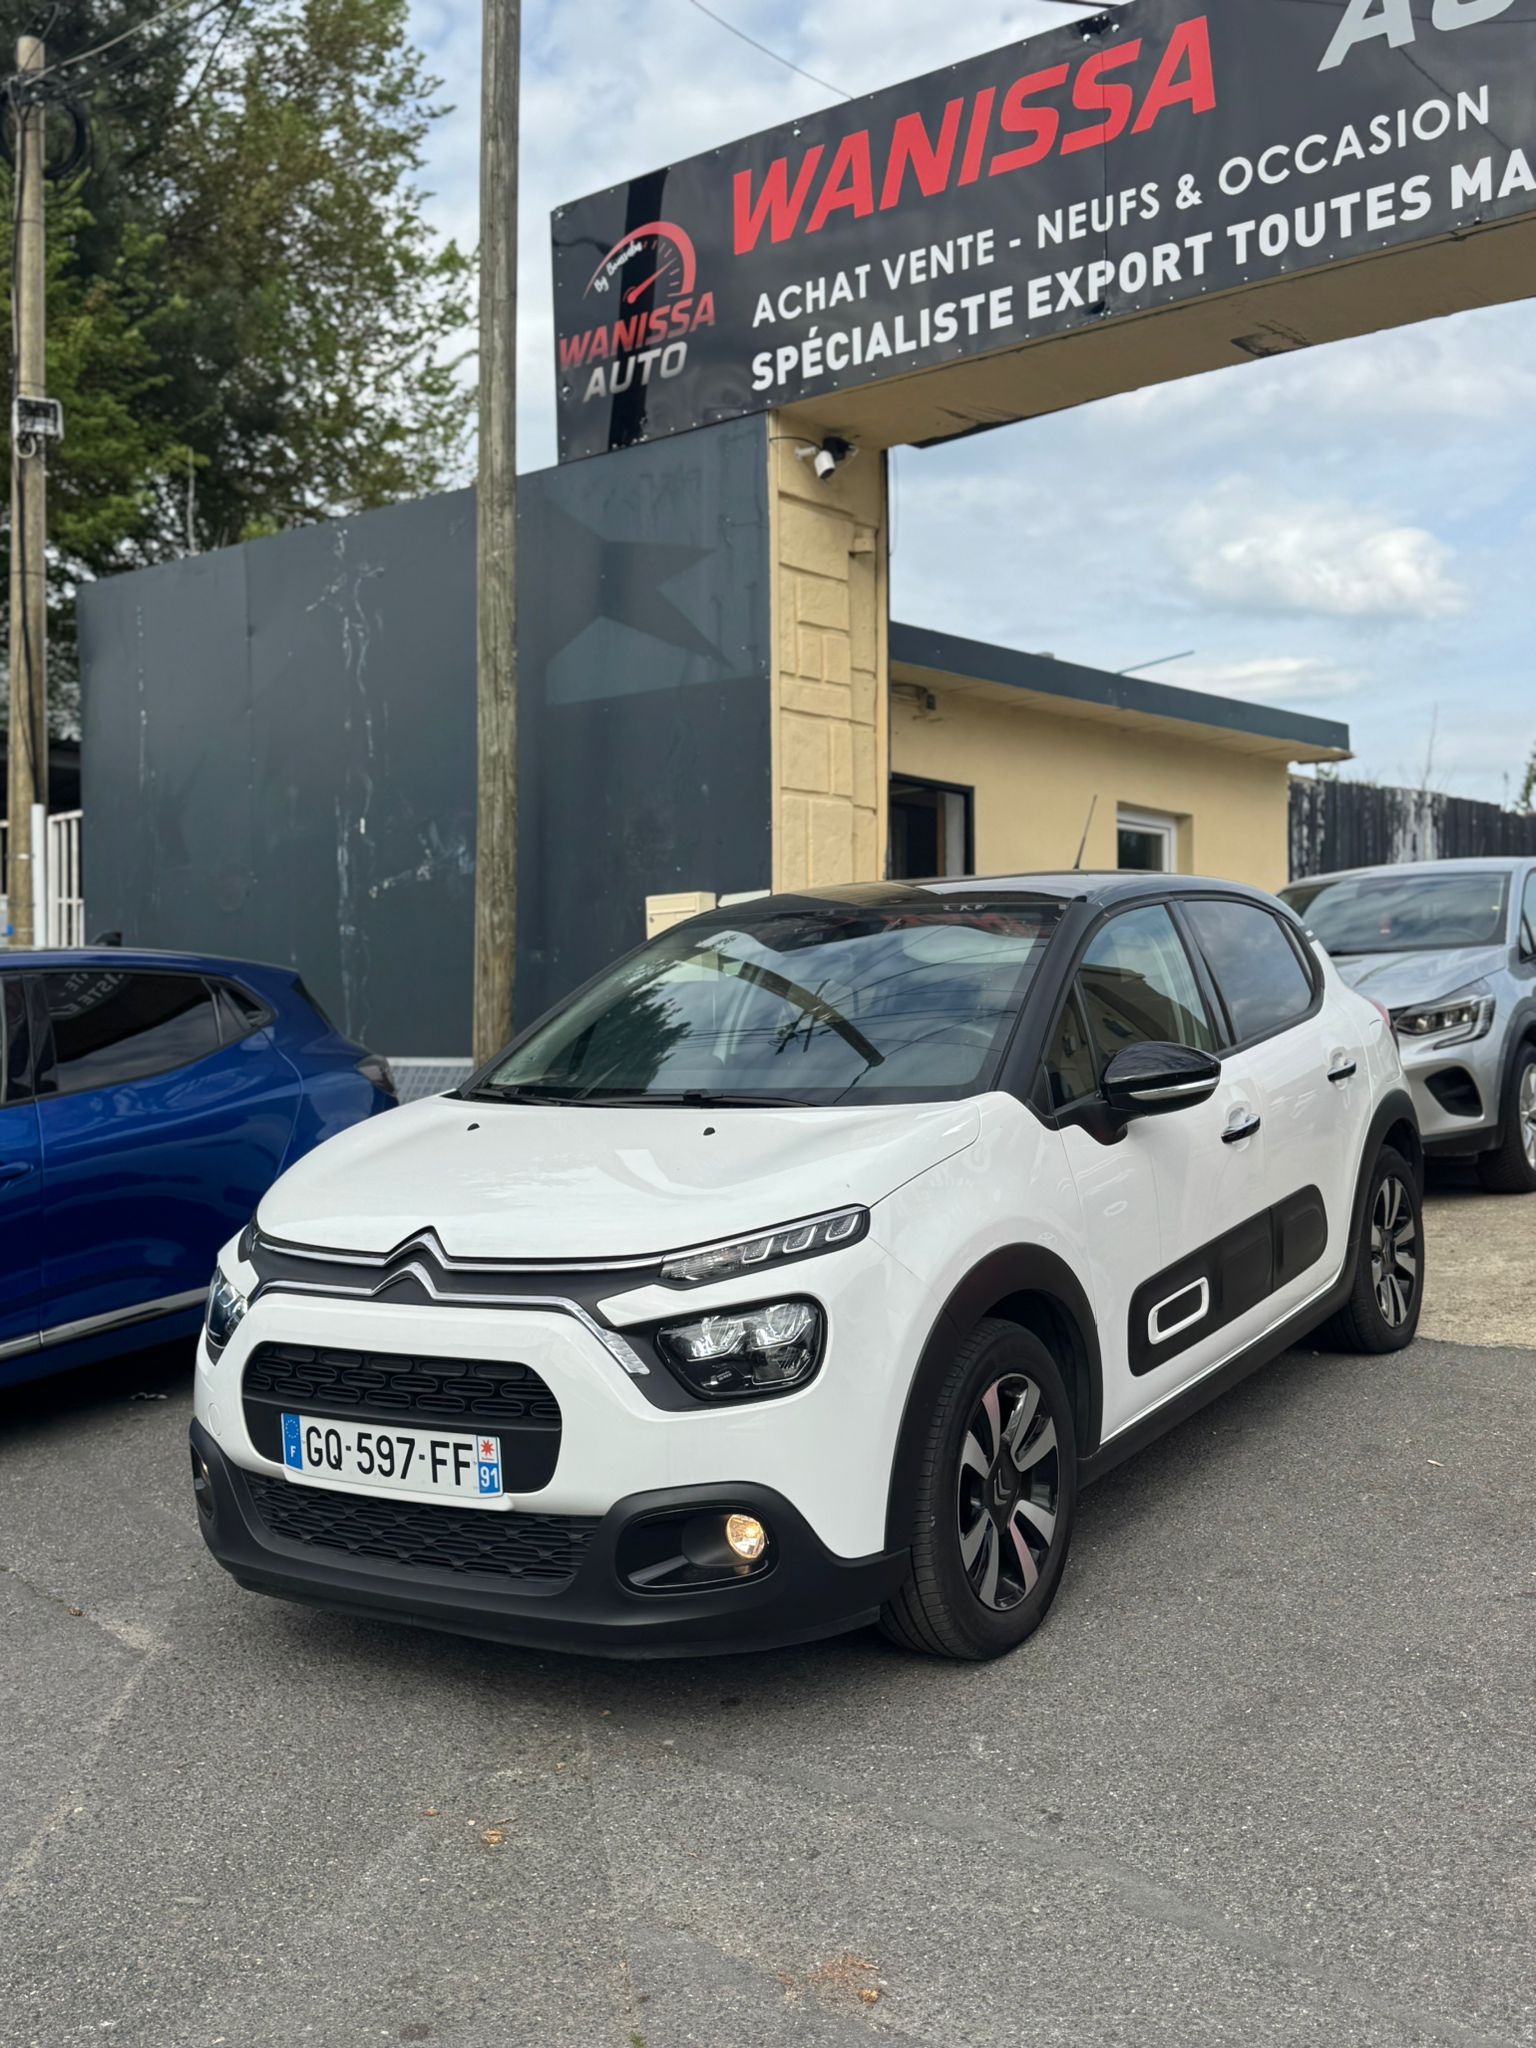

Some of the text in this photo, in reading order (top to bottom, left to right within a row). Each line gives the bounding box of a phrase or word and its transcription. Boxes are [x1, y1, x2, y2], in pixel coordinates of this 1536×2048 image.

[733, 15, 1217, 256] WANISSA
[751, 264, 871, 327] ACHAT
[881, 228, 995, 290] VENTE
[1037, 182, 1160, 249] NEUFS
[1175, 173, 1203, 210] &
[1218, 84, 1490, 196] OCCASION
[751, 286, 1014, 391] SPÉCIALISTE
[1027, 231, 1213, 319] EXPORT
[1226, 174, 1432, 265] TOUTES
[559, 291, 716, 372] WANISSA
[582, 341, 688, 404] AUTO
[290, 1445, 296, 1458] F
[305, 1425, 474, 1487] GQ-597-FF
[480, 1465, 499, 1488] 91
